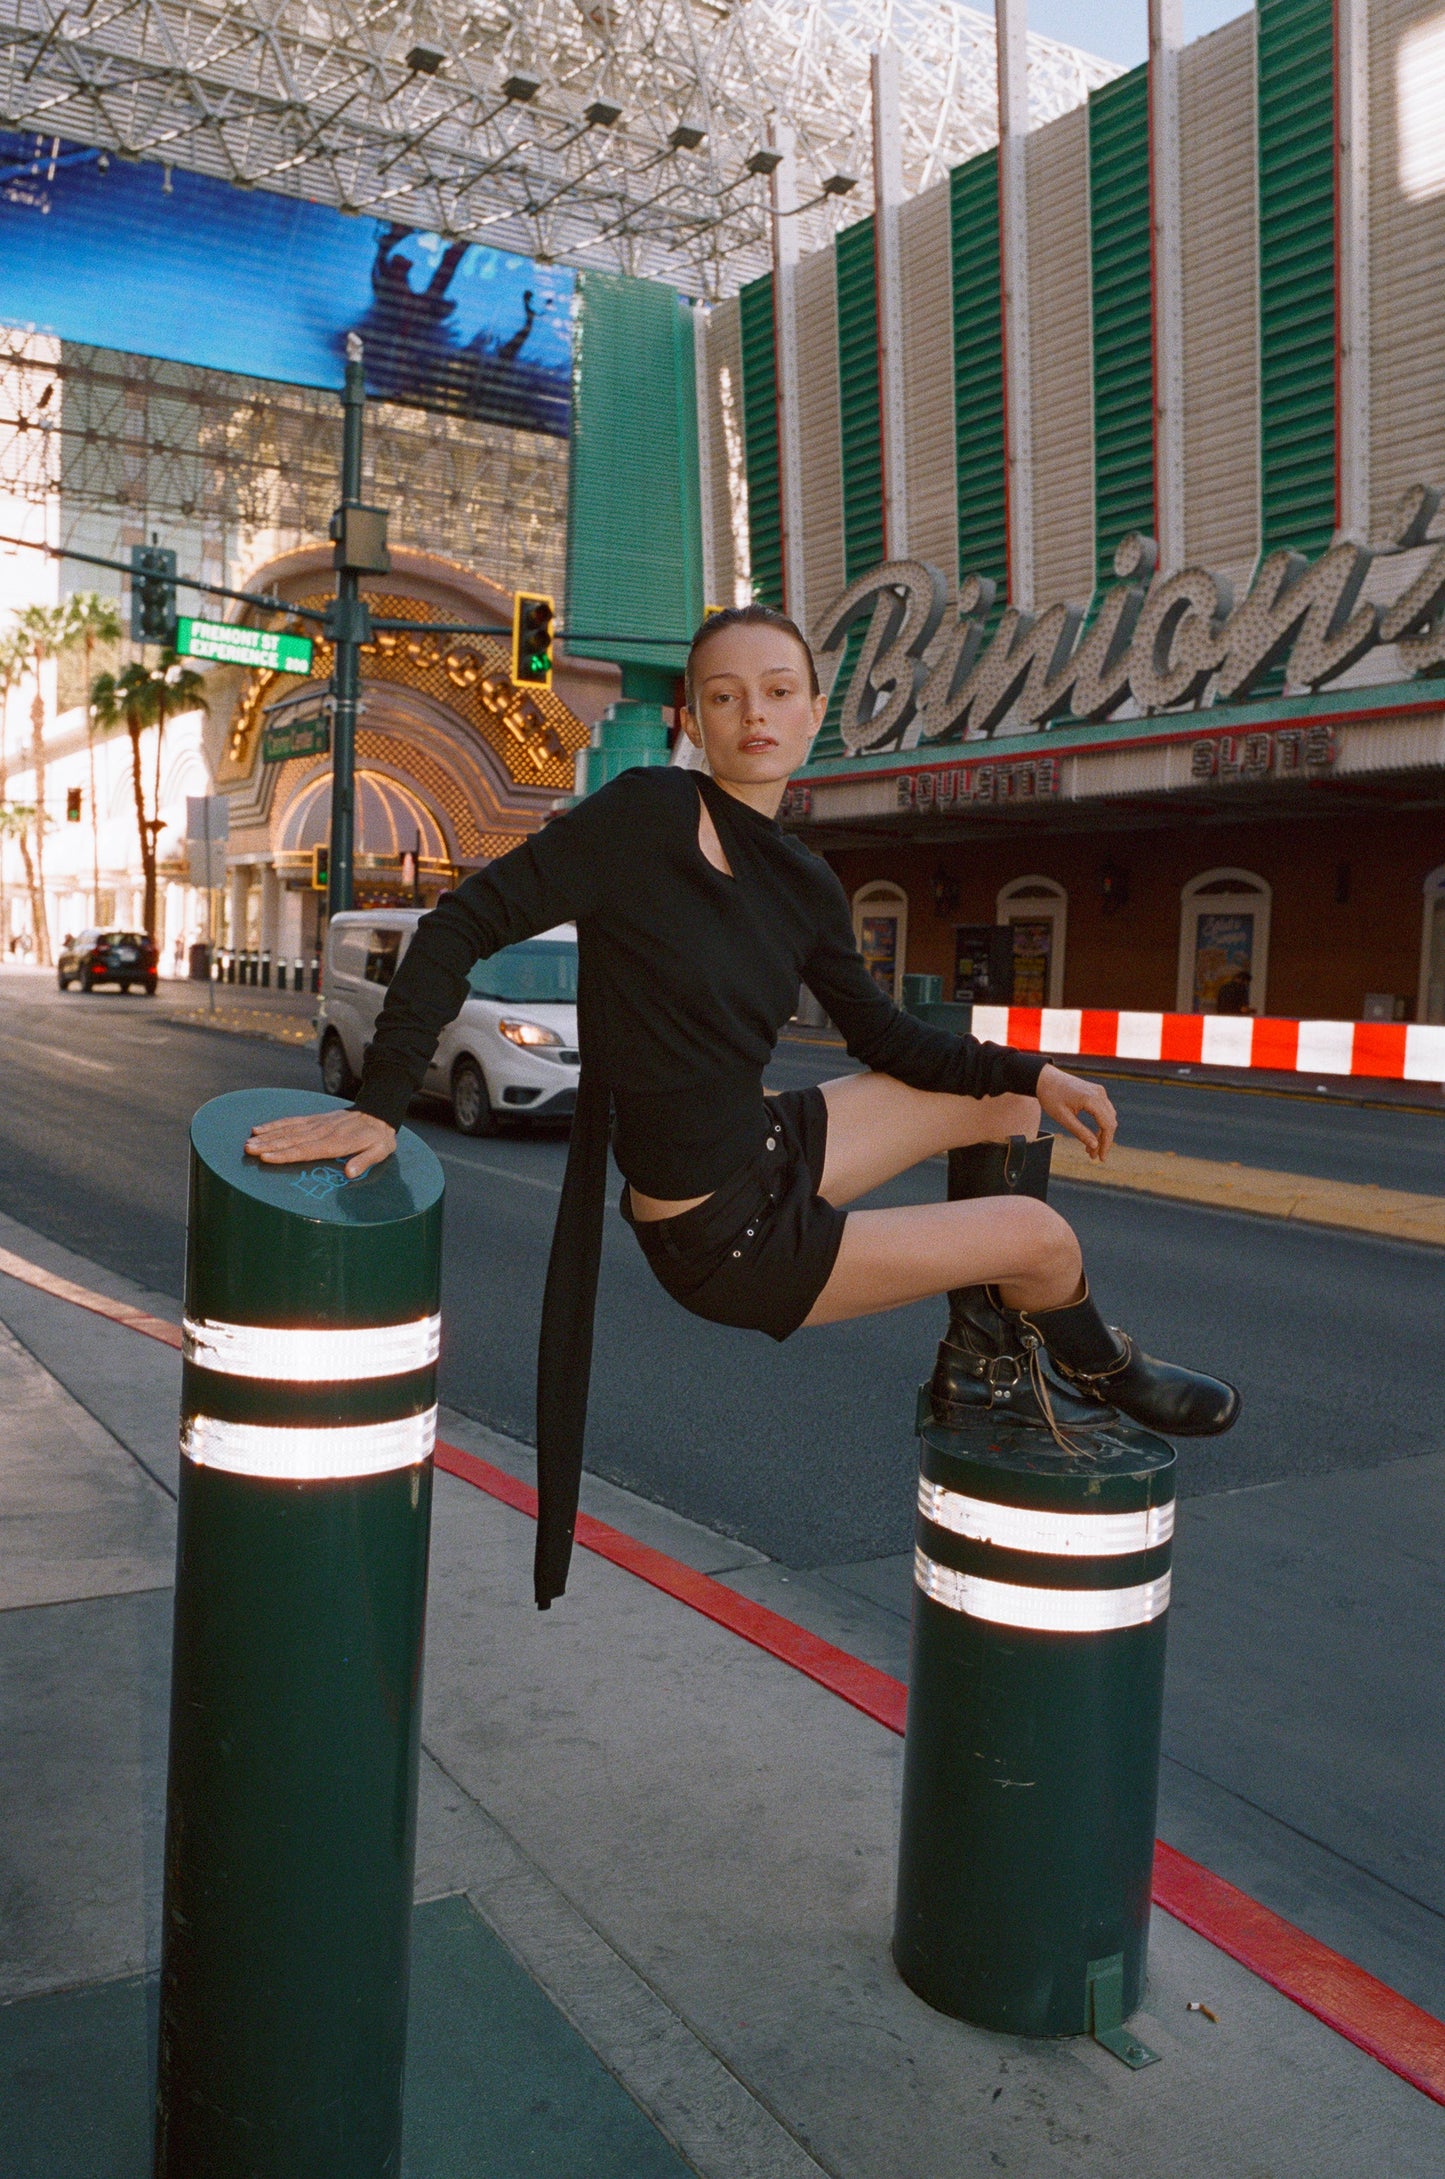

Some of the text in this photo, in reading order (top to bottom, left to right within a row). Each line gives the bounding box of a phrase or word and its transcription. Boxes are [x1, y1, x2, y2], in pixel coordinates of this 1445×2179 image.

[189, 638, 279, 669] EXPERIENCE
[191, 621, 280, 651] FREMONT ST
[1190, 724, 1336, 778] SLOTS
[896, 757, 1061, 807] ROULETTE
